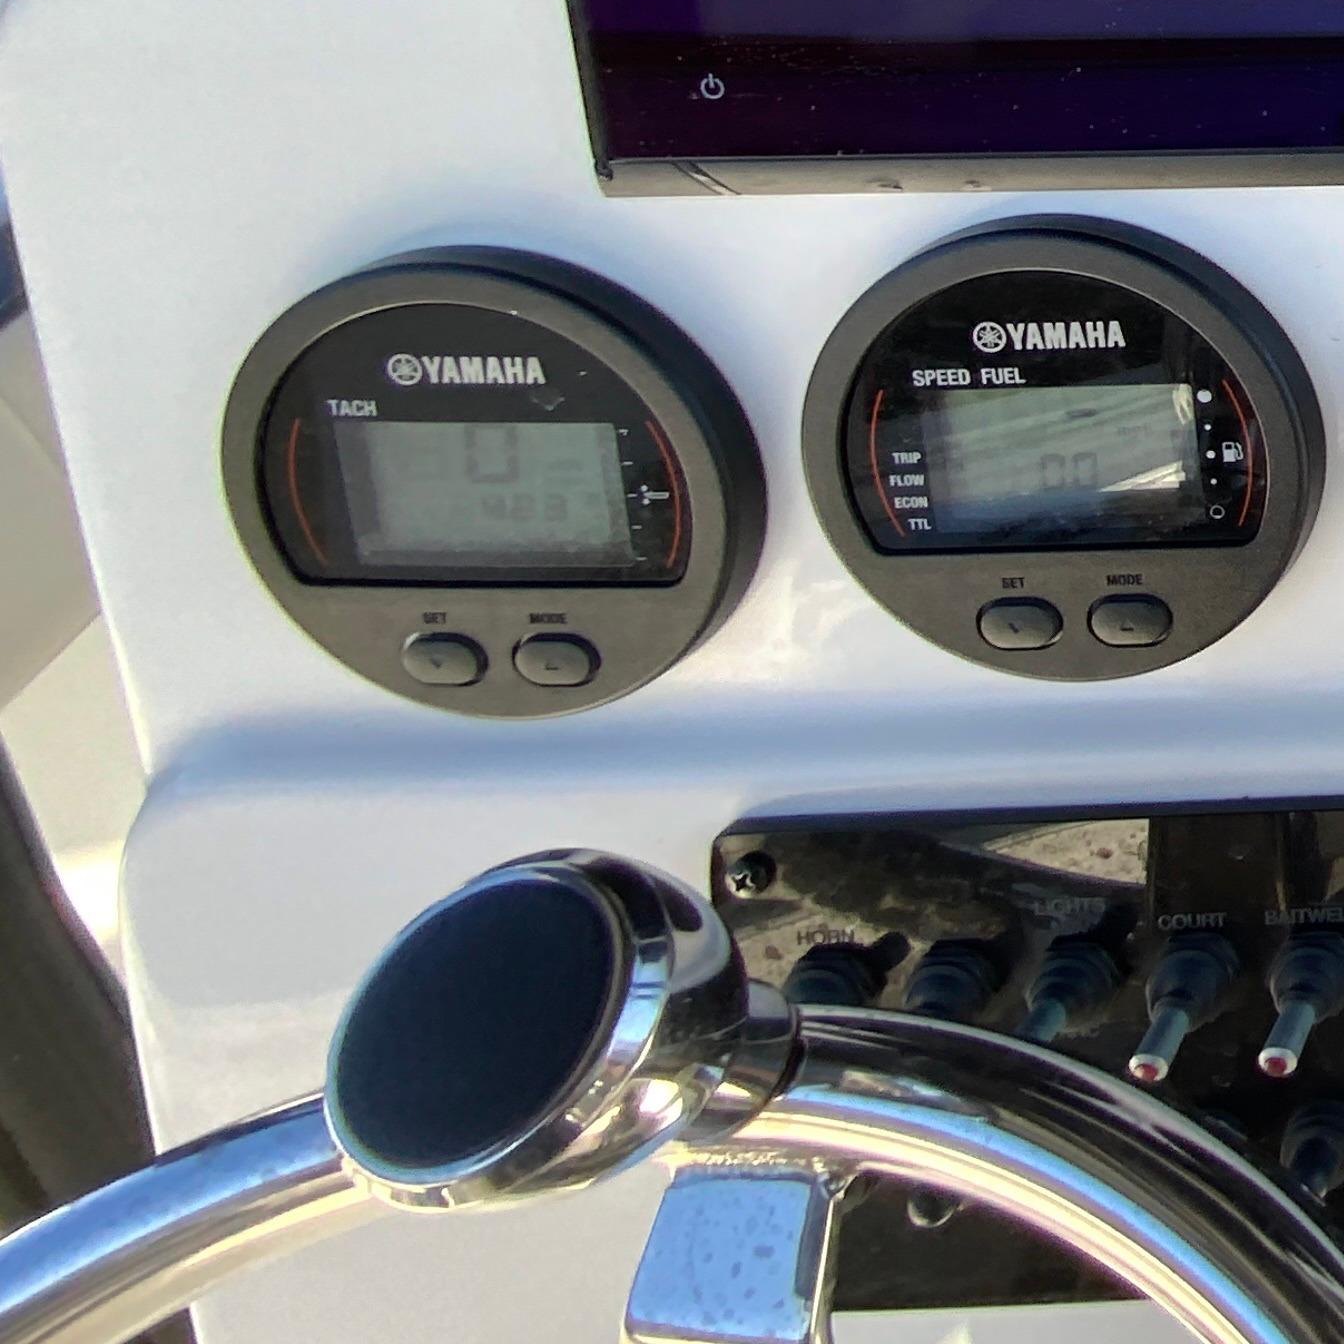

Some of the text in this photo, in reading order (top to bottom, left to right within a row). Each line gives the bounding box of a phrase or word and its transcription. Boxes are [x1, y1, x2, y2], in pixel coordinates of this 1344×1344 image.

[1006, 321, 1126, 351] YAMAHA
[423, 356, 546, 385] YAMAHA
[912, 367, 1026, 386] SPEED FUEL
[328, 399, 377, 416] TACH
[892, 452, 922, 464] TRIP
[889, 474, 925, 487] FLOW
[894, 496, 928, 509] ECON
[908, 518, 932, 531] TTL
[1002, 578, 1025, 589] SET
[1106, 574, 1143, 586] MODE
[1033, 896, 1108, 917] LIGHTS
[1157, 910, 1227, 932] COURT
[796, 928, 856, 947] HORN
